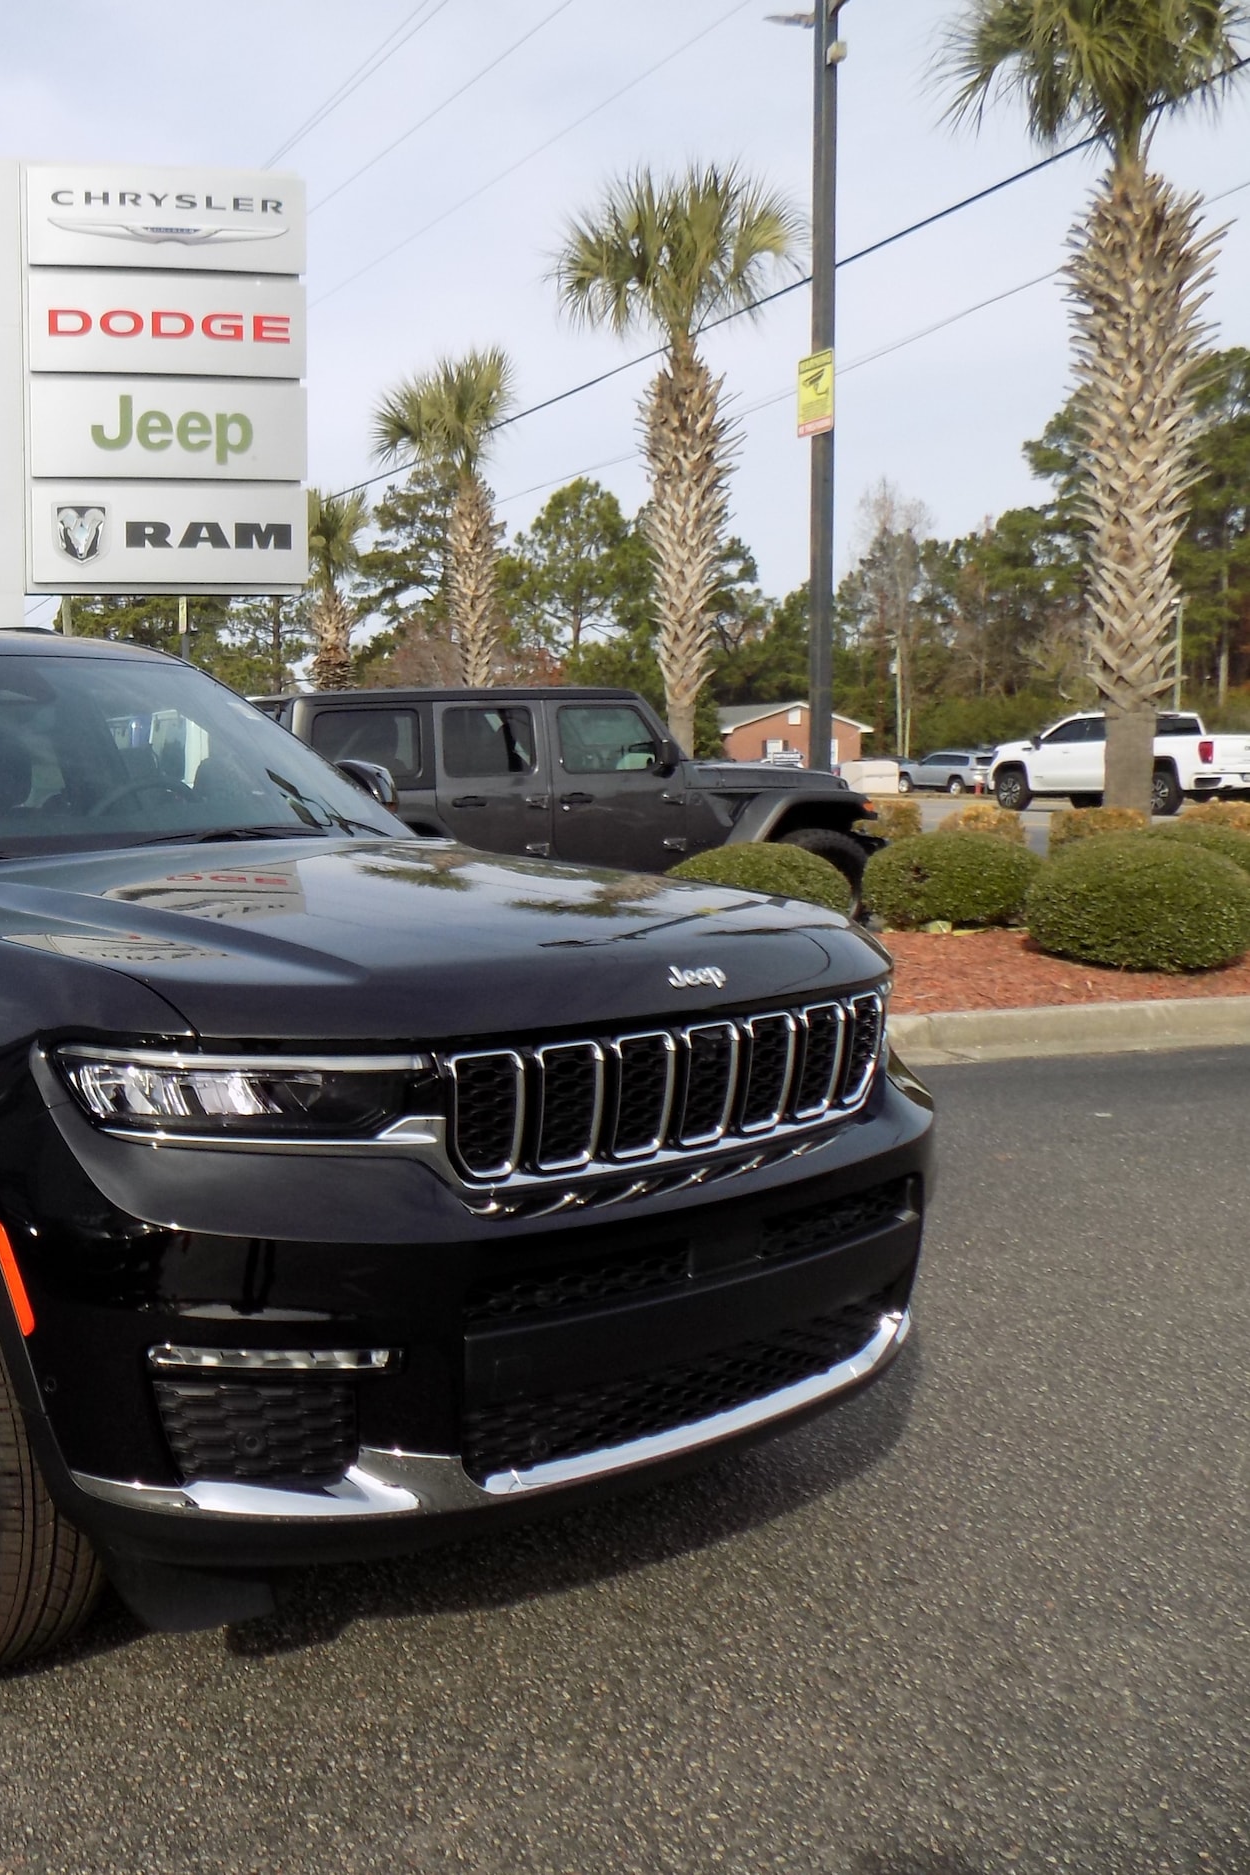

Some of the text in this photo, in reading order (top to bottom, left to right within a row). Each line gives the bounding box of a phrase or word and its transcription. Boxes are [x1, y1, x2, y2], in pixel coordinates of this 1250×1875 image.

[51, 190, 284, 215] CHRYSLER
[48, 309, 291, 344] DODGE
[91, 394, 253, 466] Jeep
[125, 521, 292, 550] RAM
[668, 965, 727, 990] Jeep
